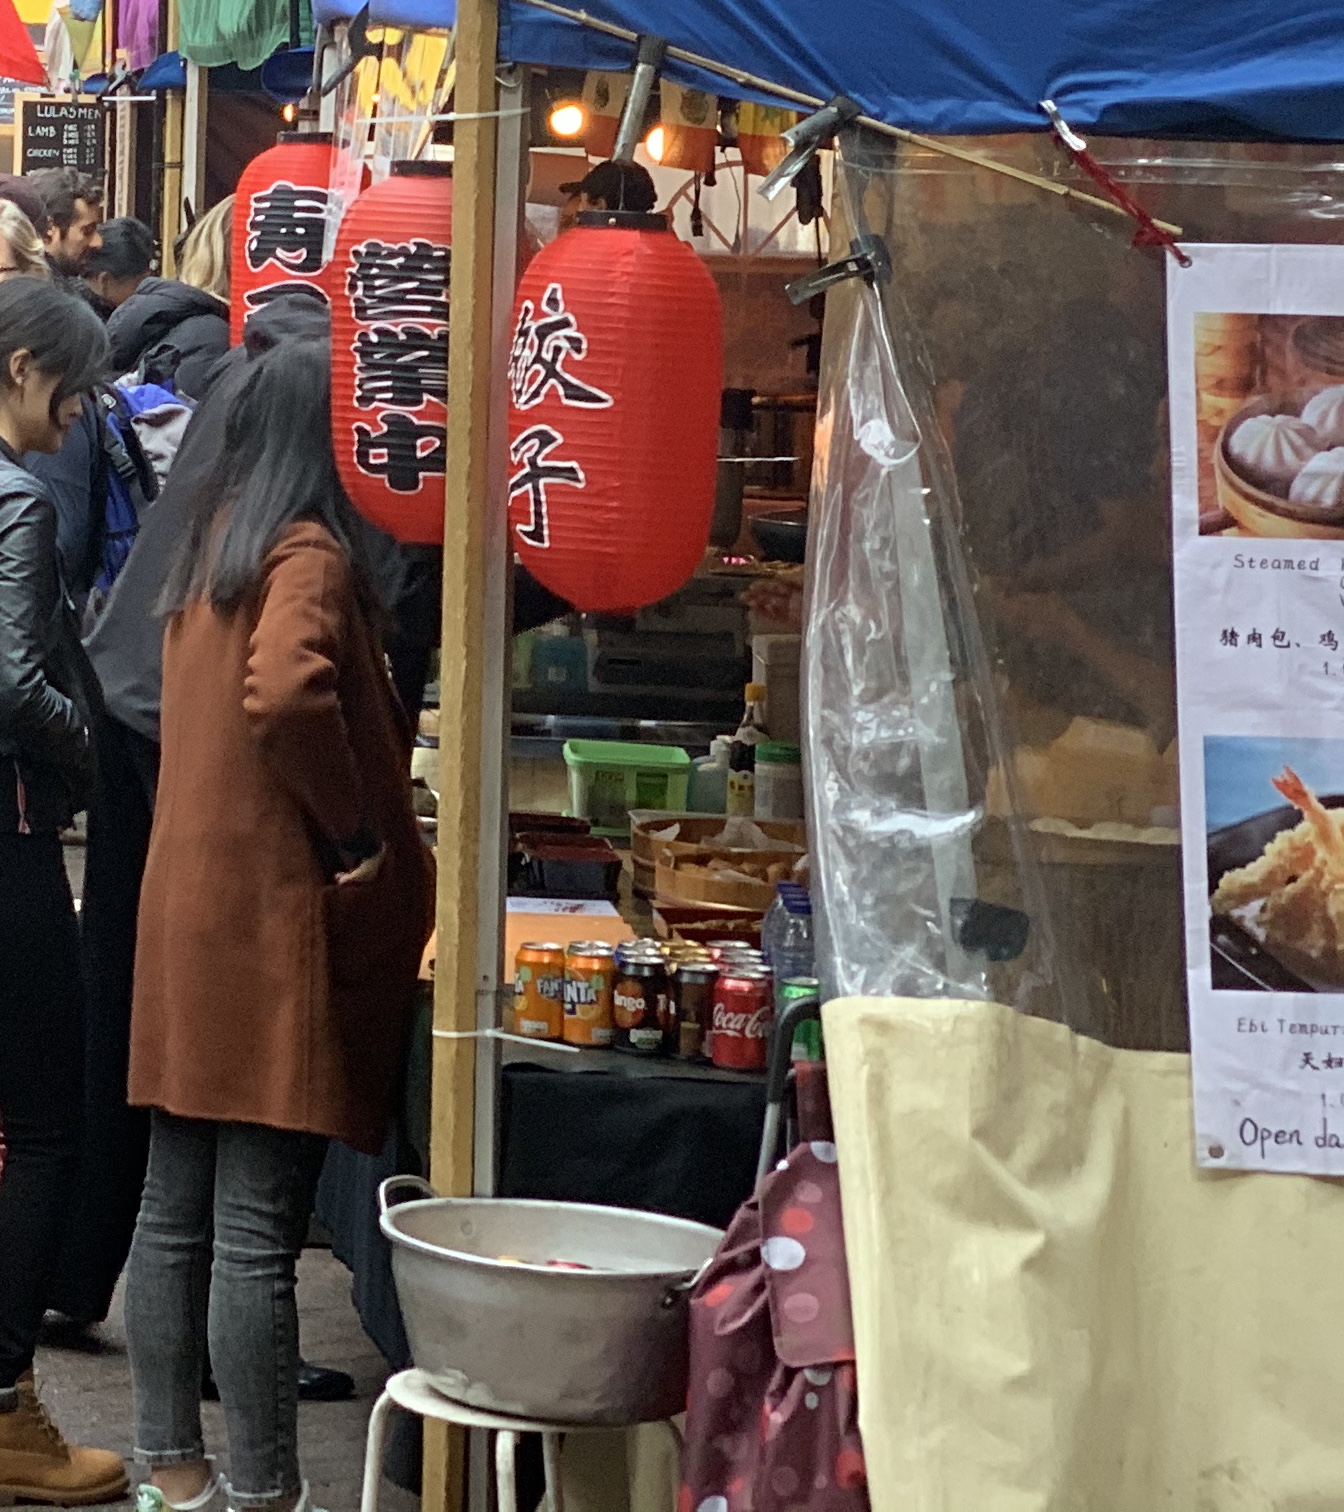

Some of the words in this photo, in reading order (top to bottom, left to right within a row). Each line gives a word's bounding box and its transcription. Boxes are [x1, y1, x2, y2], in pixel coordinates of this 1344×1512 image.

[77, 107, 102, 119] MEN
[28, 125, 57, 138] LAMB
[26, 148, 60, 158] CHICKEN
[1233, 553, 1321, 571] Steamed
[1237, 1017, 1269, 1033] Ebi
[1276, 1018, 1344, 1038] Tempur
[1239, 1116, 1304, 1160] Open
[1314, 1116, 1344, 1149] da
